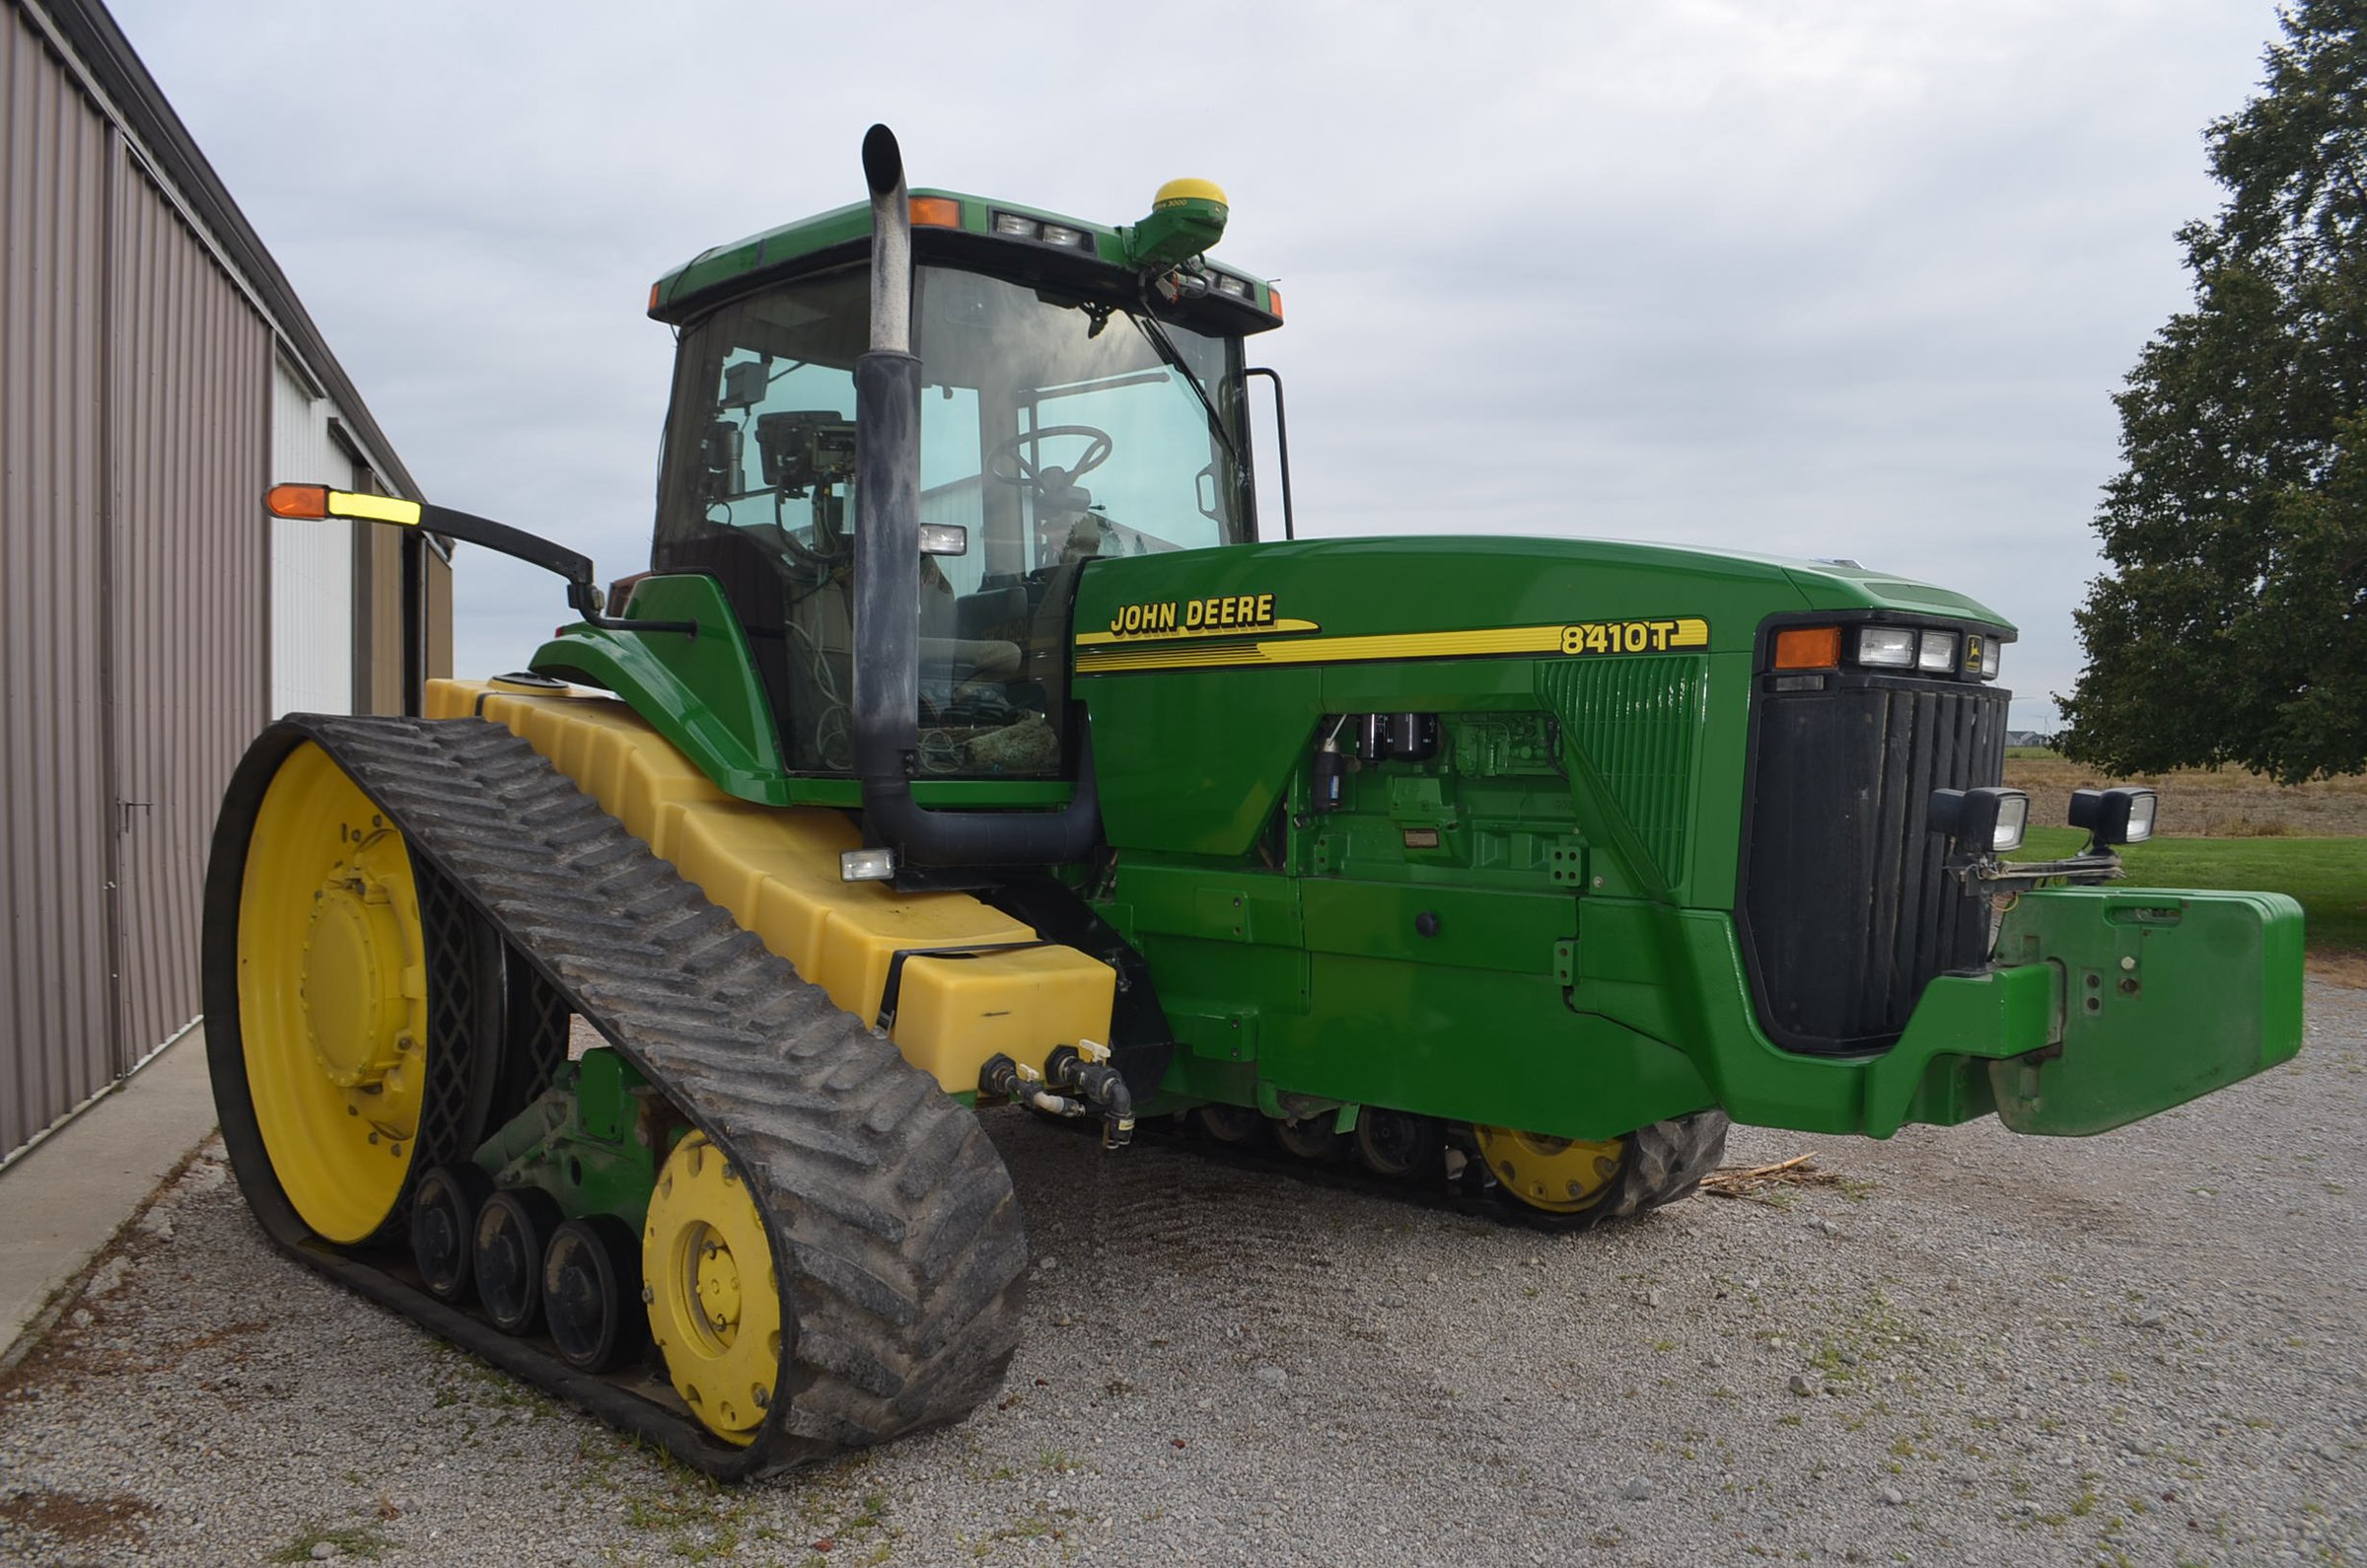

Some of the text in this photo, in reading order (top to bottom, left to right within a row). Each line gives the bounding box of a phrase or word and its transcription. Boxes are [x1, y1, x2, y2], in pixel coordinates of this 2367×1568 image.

[1111, 594, 1274, 633] JOHN DEERE
[1561, 621, 1676, 655] 8410T
